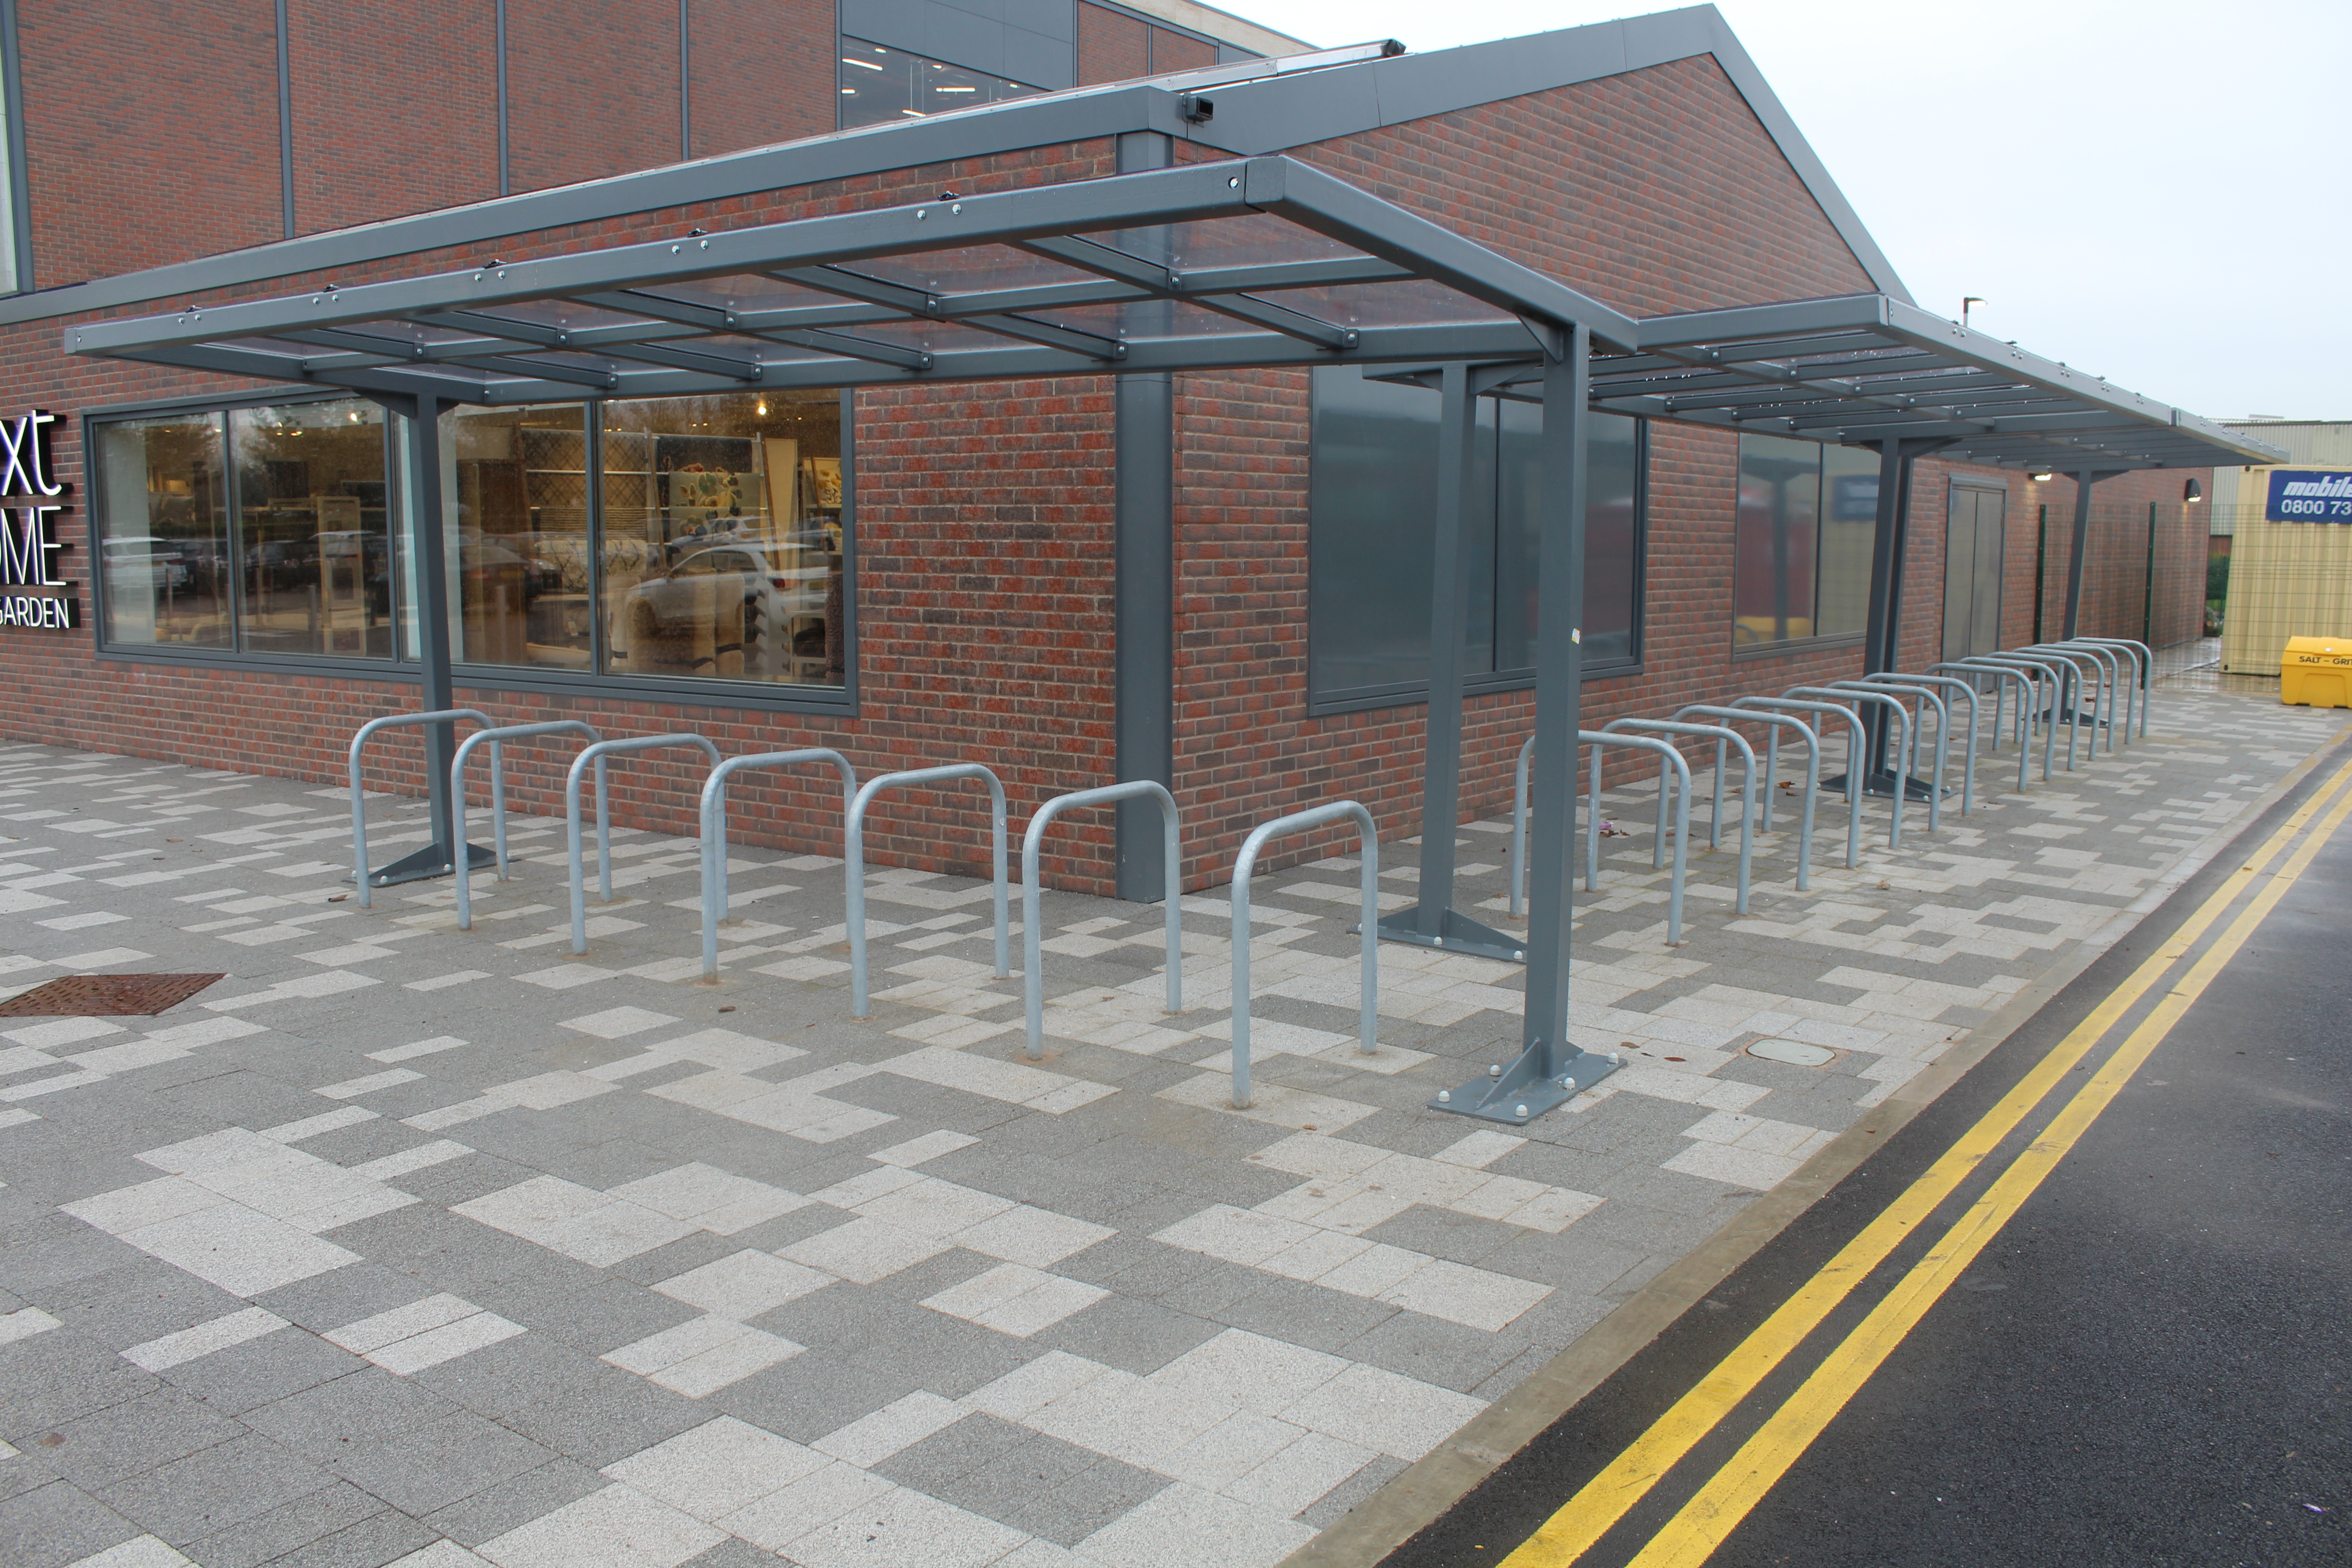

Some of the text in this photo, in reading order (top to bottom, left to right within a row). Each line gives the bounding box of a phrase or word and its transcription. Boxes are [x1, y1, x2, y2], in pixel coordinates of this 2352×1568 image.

[2281, 499, 2352, 515] 0800 73
[0, 506, 67, 585] ME
